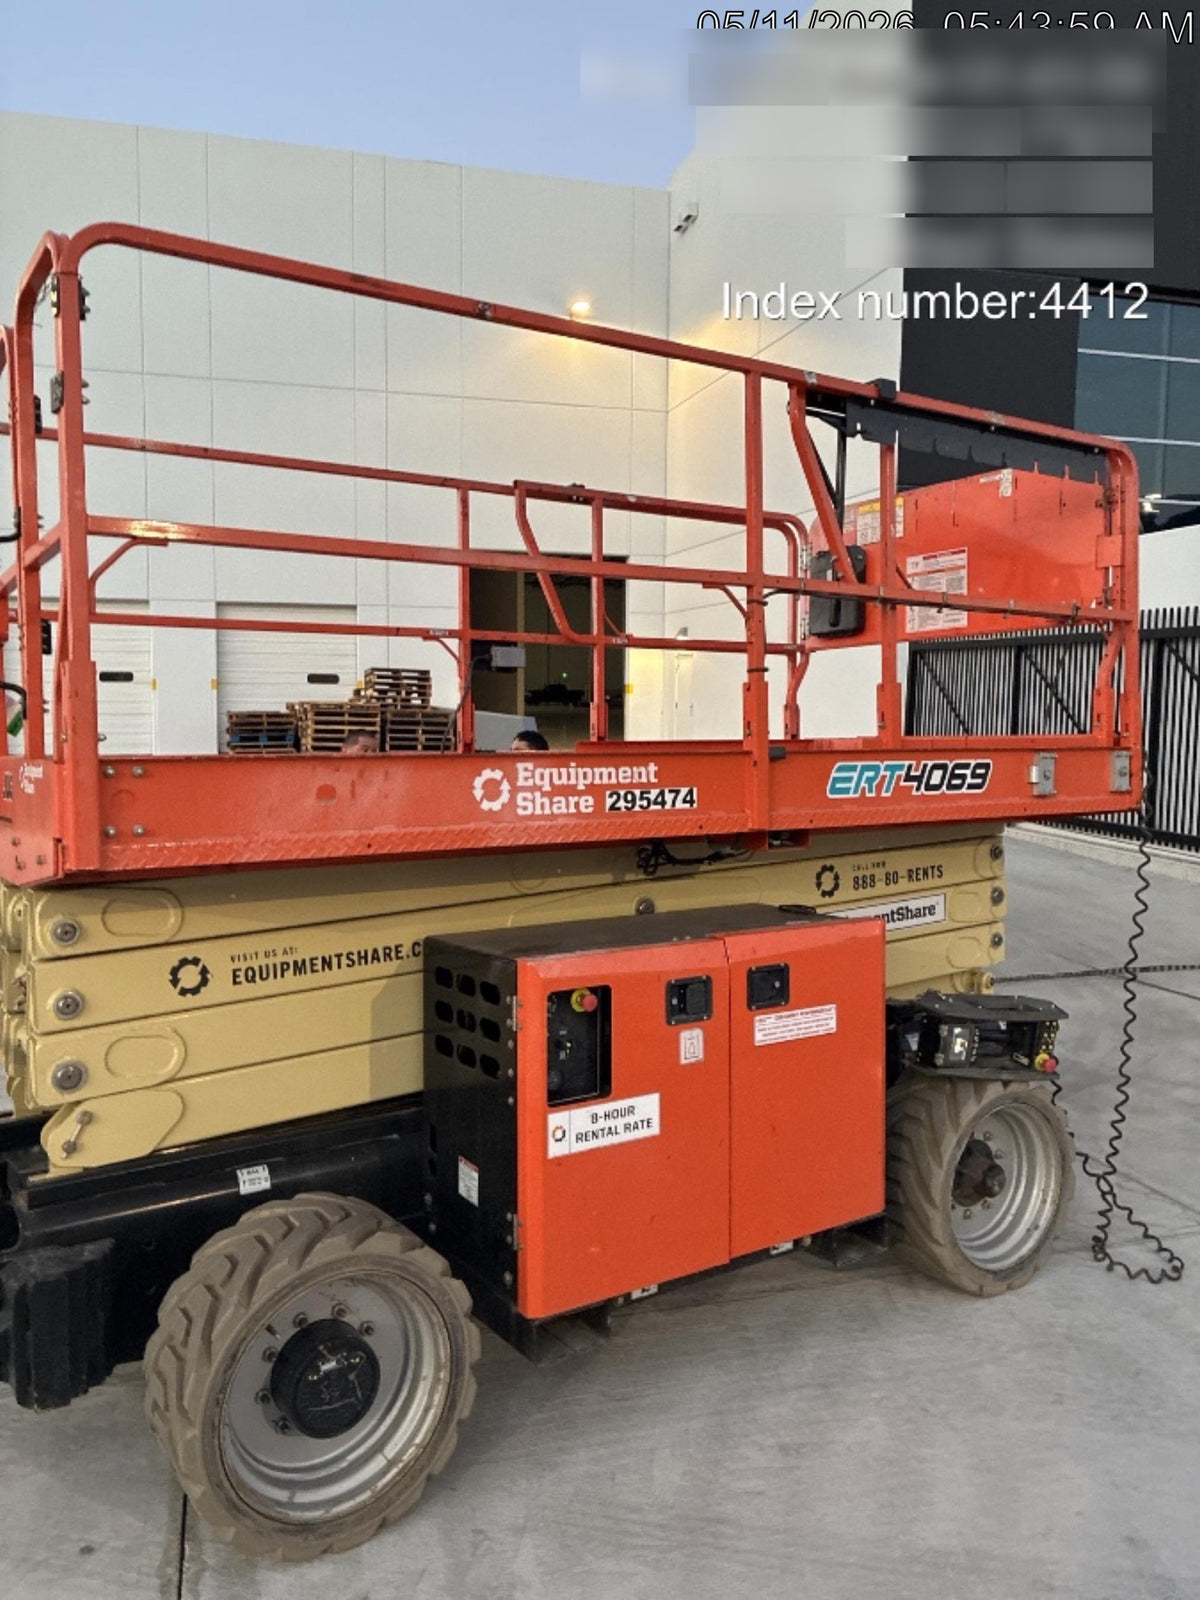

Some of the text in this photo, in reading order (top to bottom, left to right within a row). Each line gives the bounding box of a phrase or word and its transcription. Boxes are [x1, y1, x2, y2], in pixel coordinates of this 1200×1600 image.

[516, 761, 658, 791] Equipment
[827, 760, 992, 798] ERT4069
[516, 791, 595, 815] Share
[607, 788, 696, 812] 295474
[230, 951, 259, 964] VISIT
[264, 949, 278, 958] US
[591, 1105, 636, 1124] 8-HOUR
[575, 1118, 653, 1143] RENTAL RATE
